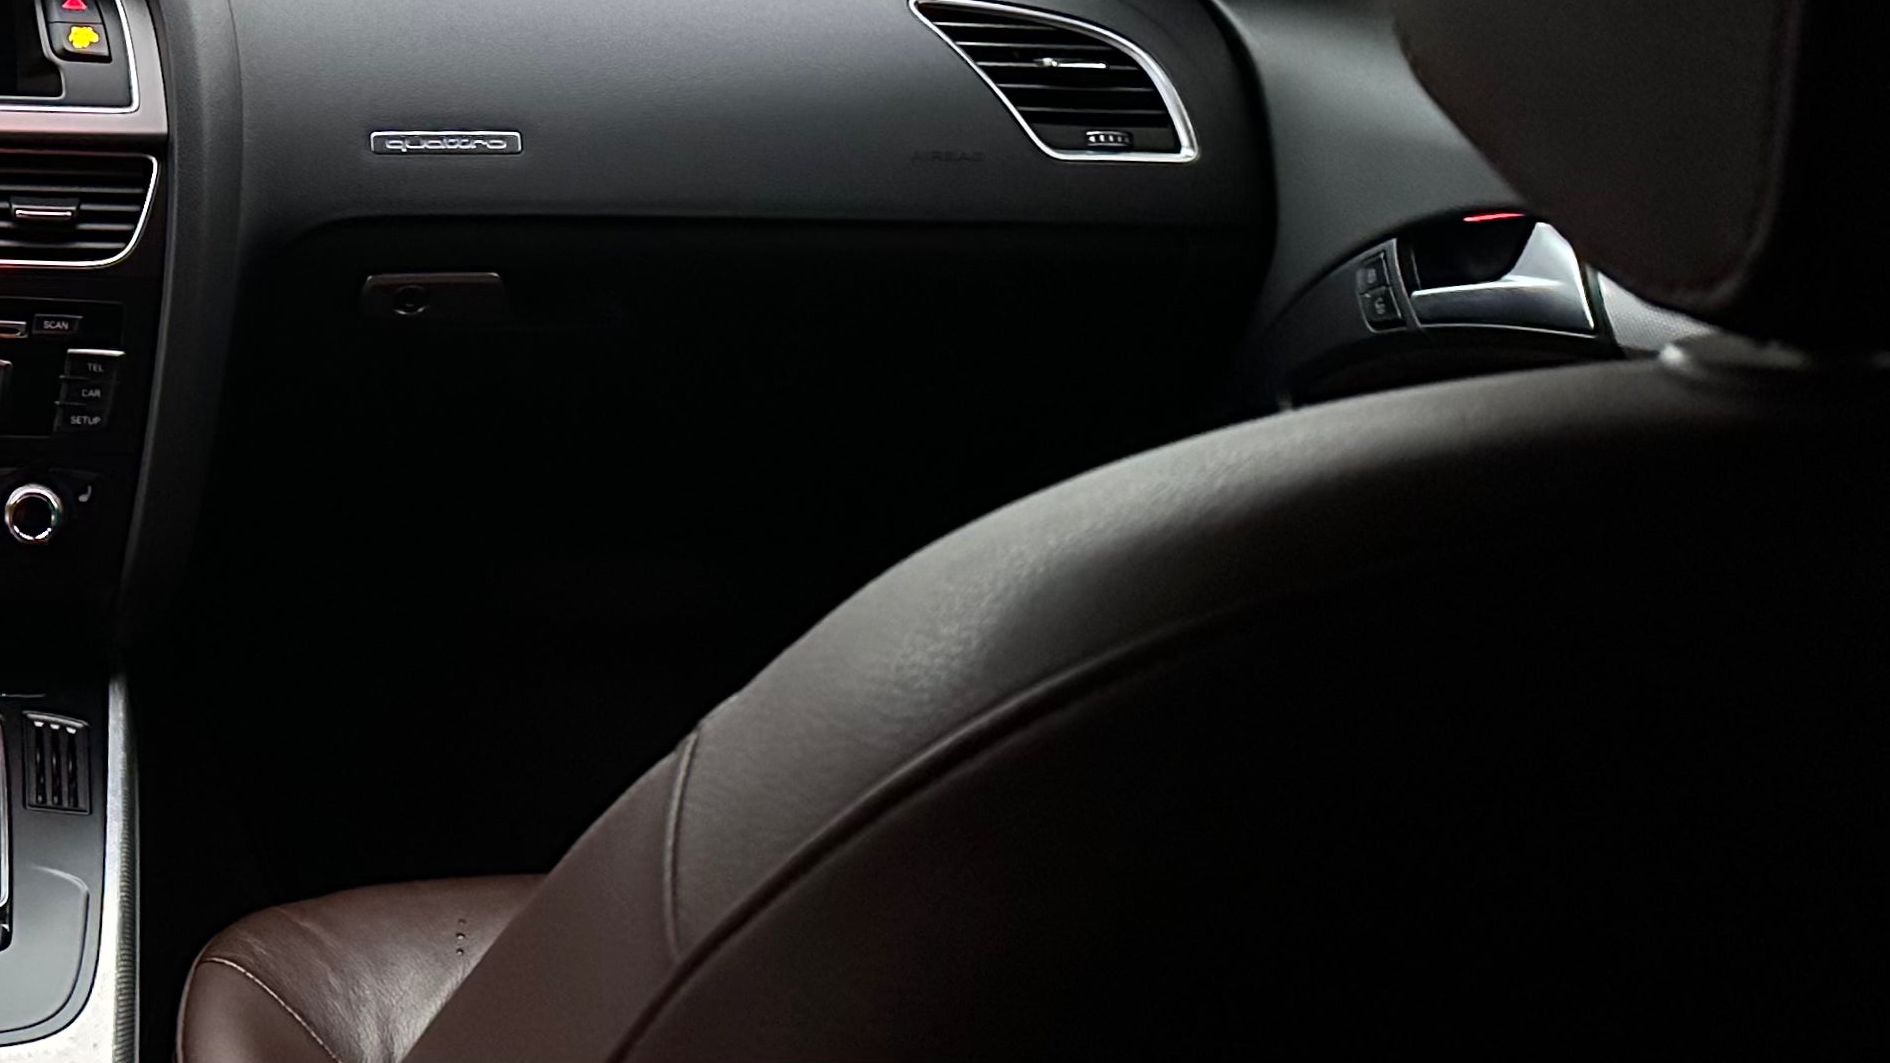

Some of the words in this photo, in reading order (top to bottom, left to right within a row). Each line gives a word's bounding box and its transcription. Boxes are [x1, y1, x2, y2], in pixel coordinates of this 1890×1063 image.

[385, 137, 507, 152] quattro
[43, 320, 70, 330] SCAN
[87, 362, 104, 372] TEL
[81, 388, 102, 398] CAR
[70, 415, 102, 426] SETUP
